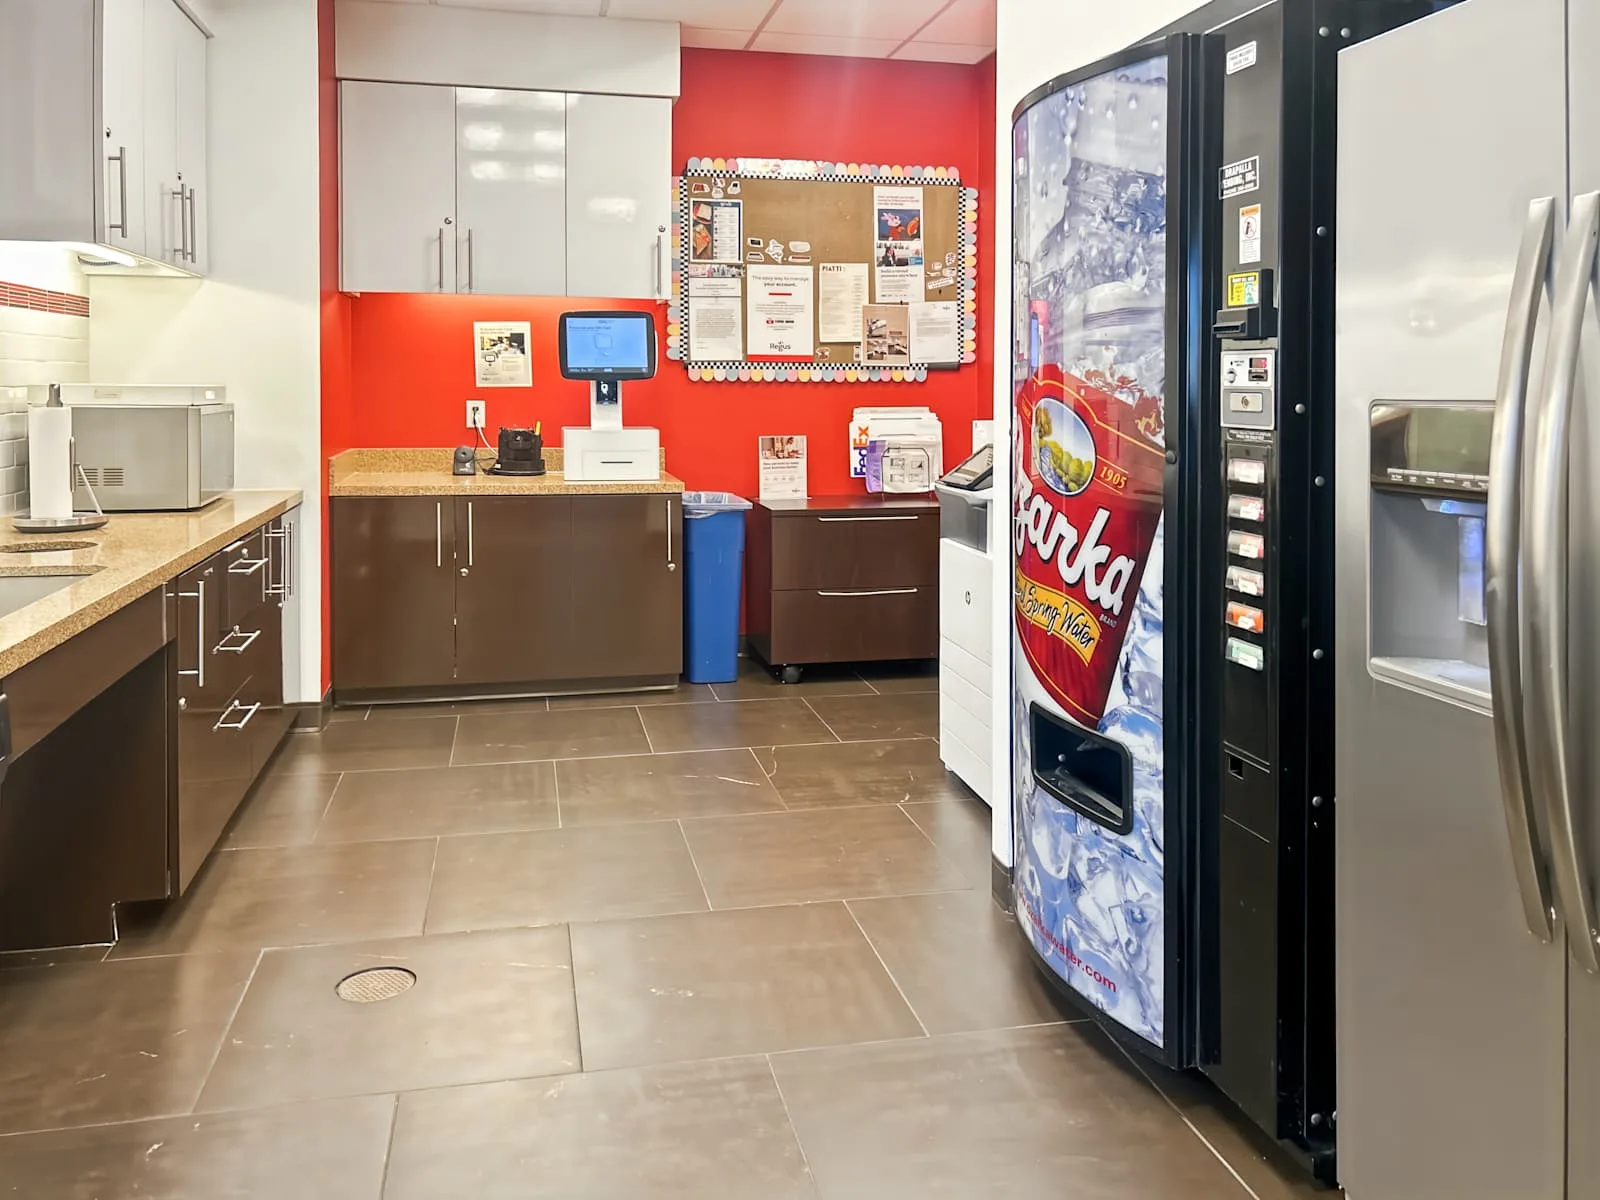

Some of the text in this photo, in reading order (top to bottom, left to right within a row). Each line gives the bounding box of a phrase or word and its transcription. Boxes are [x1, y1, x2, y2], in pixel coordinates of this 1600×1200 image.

[769, 341, 791, 352] Regus
[1100, 466, 1127, 489] 1905
[1026, 584, 1061, 635] Spring
[1060, 601, 1095, 649] Water
